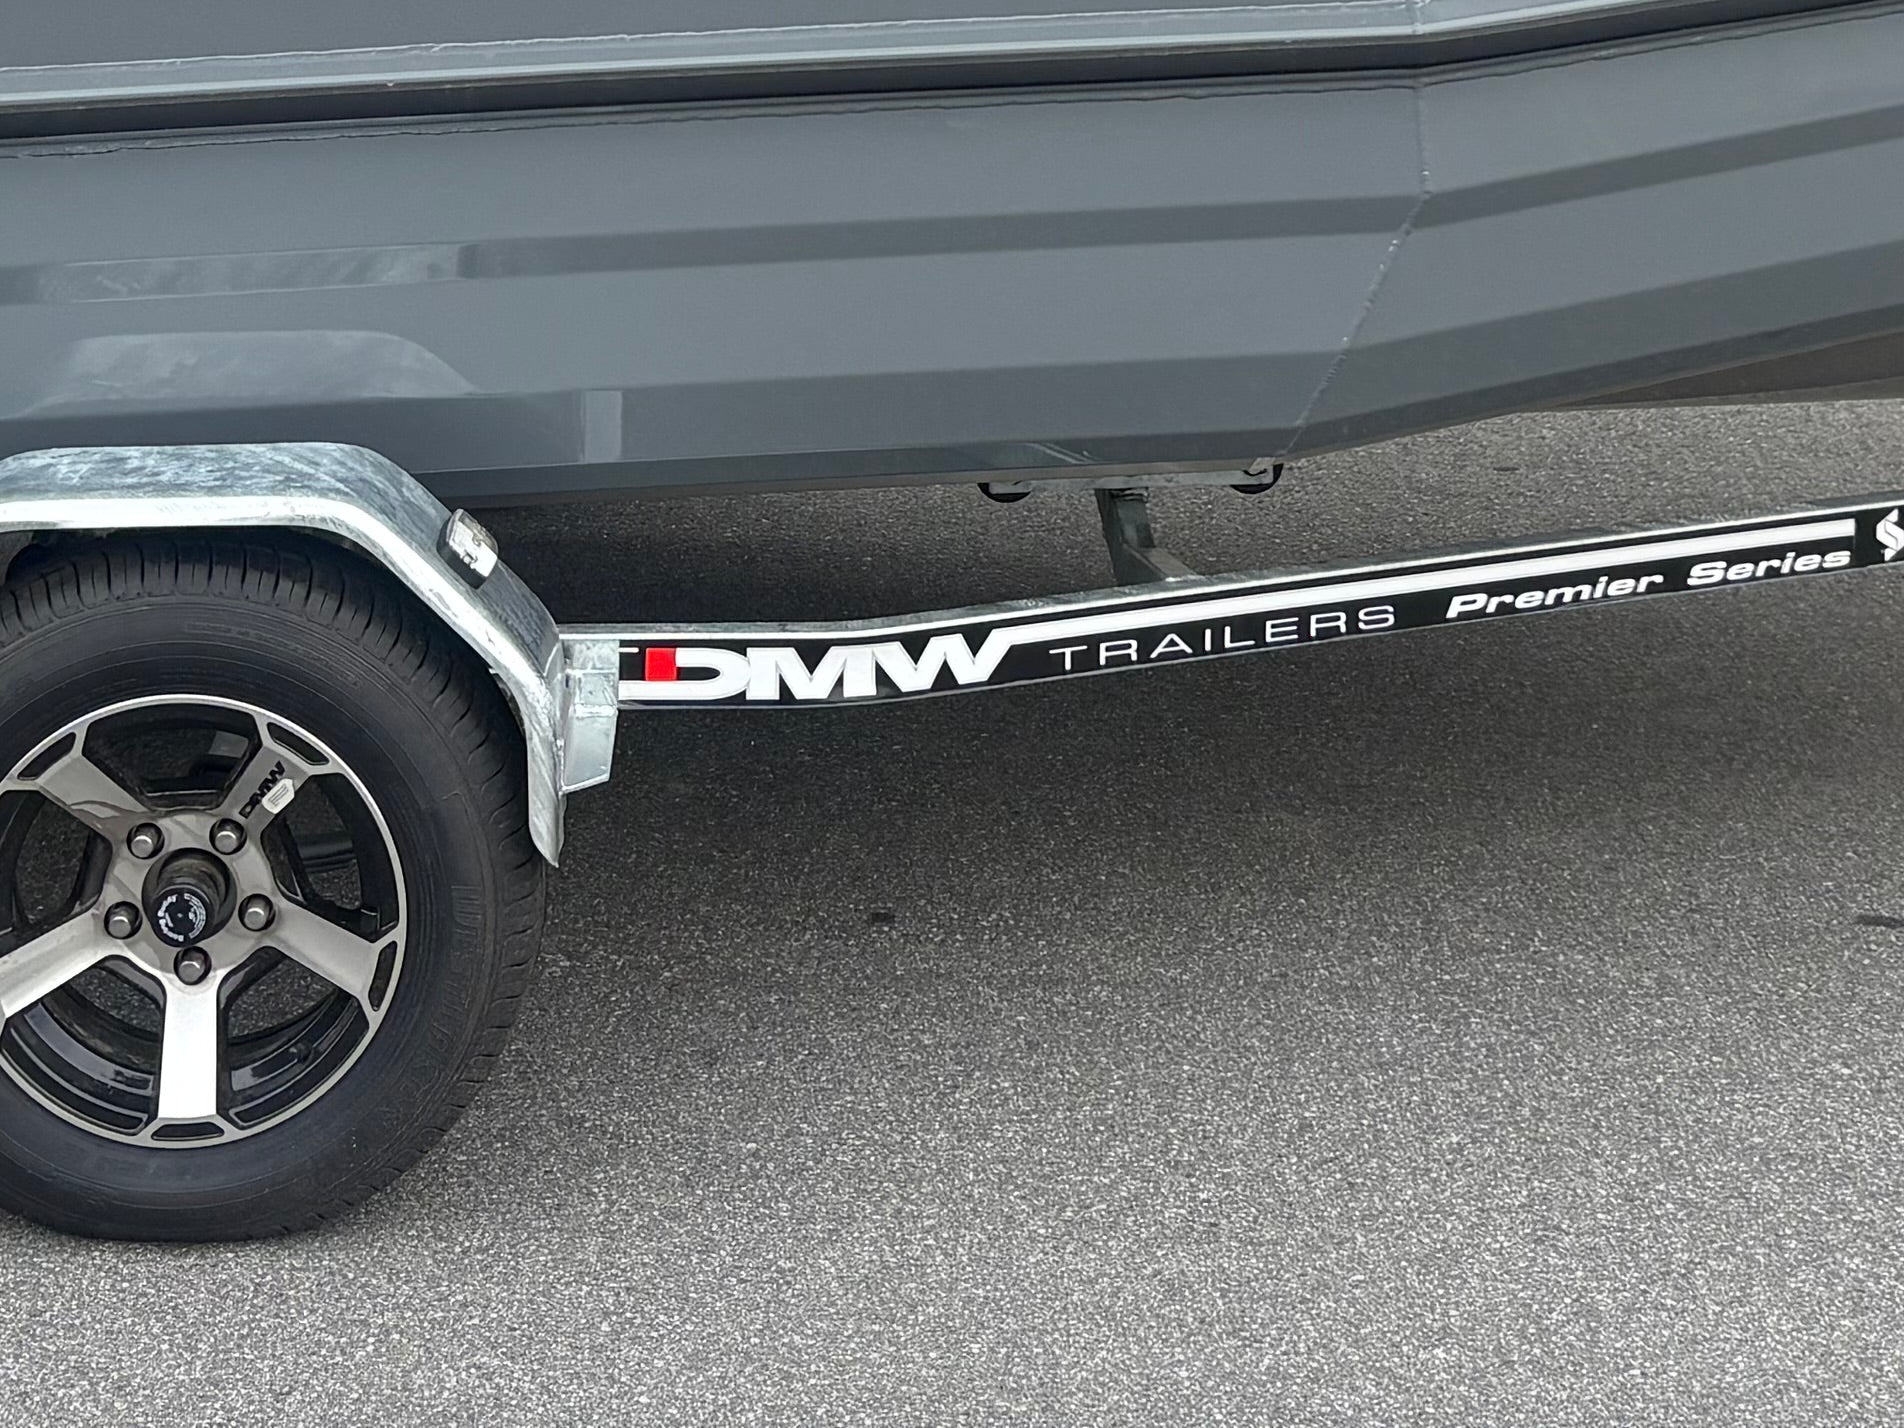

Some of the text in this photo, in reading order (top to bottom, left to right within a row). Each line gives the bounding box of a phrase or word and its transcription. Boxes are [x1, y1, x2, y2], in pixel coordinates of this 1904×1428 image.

[618, 547, 1853, 701] DMW TRAILERS Premier Series
